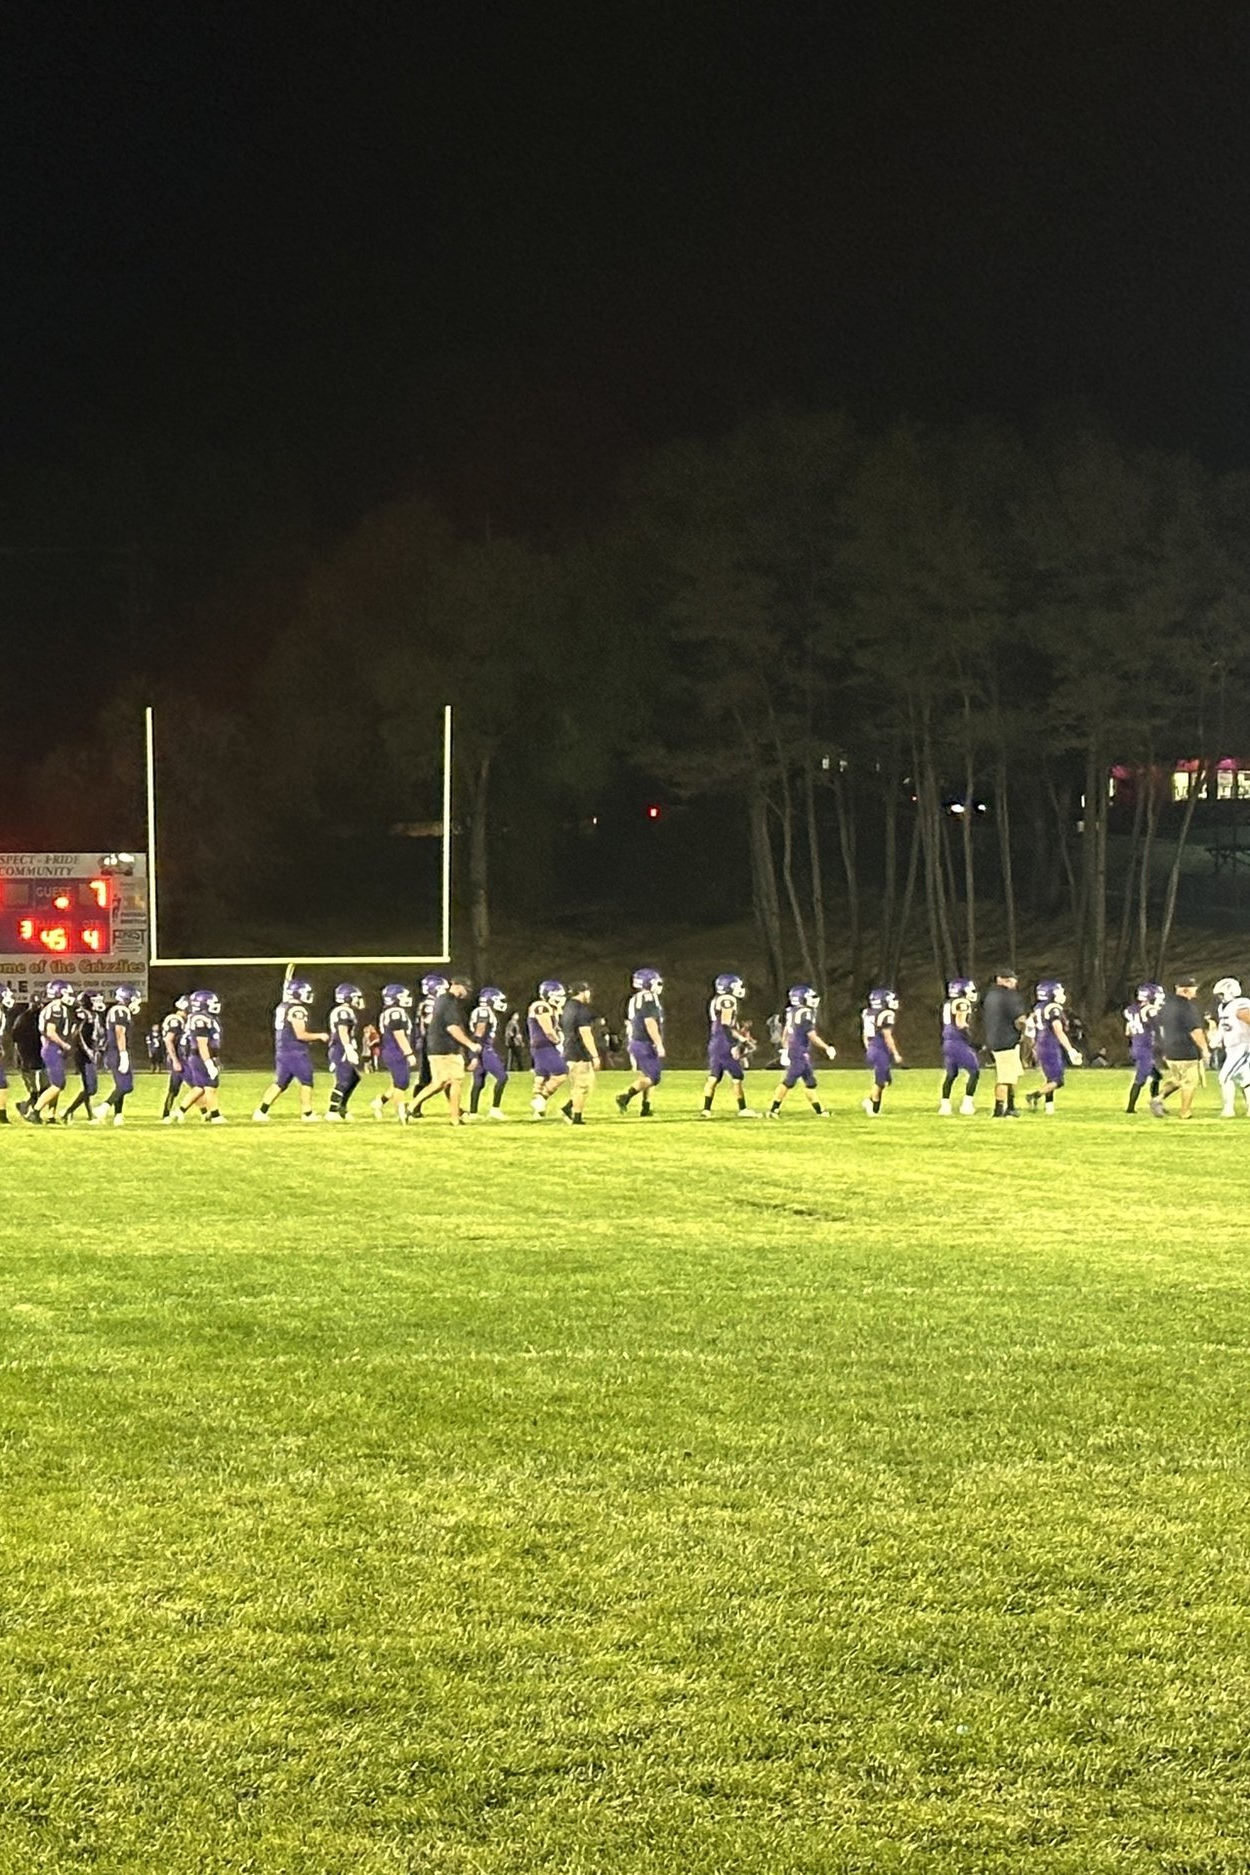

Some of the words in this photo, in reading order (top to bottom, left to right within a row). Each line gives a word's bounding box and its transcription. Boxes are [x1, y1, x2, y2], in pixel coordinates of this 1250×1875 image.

[43, 855, 80, 865] PRIDE
[35, 886, 72, 898] GUEST
[90, 881, 106, 906] 7
[83, 930, 98, 950] 4
[29, 959, 47, 975] of
[49, 959, 75, 975] the
[78, 958, 146, 975] Grizzlies
